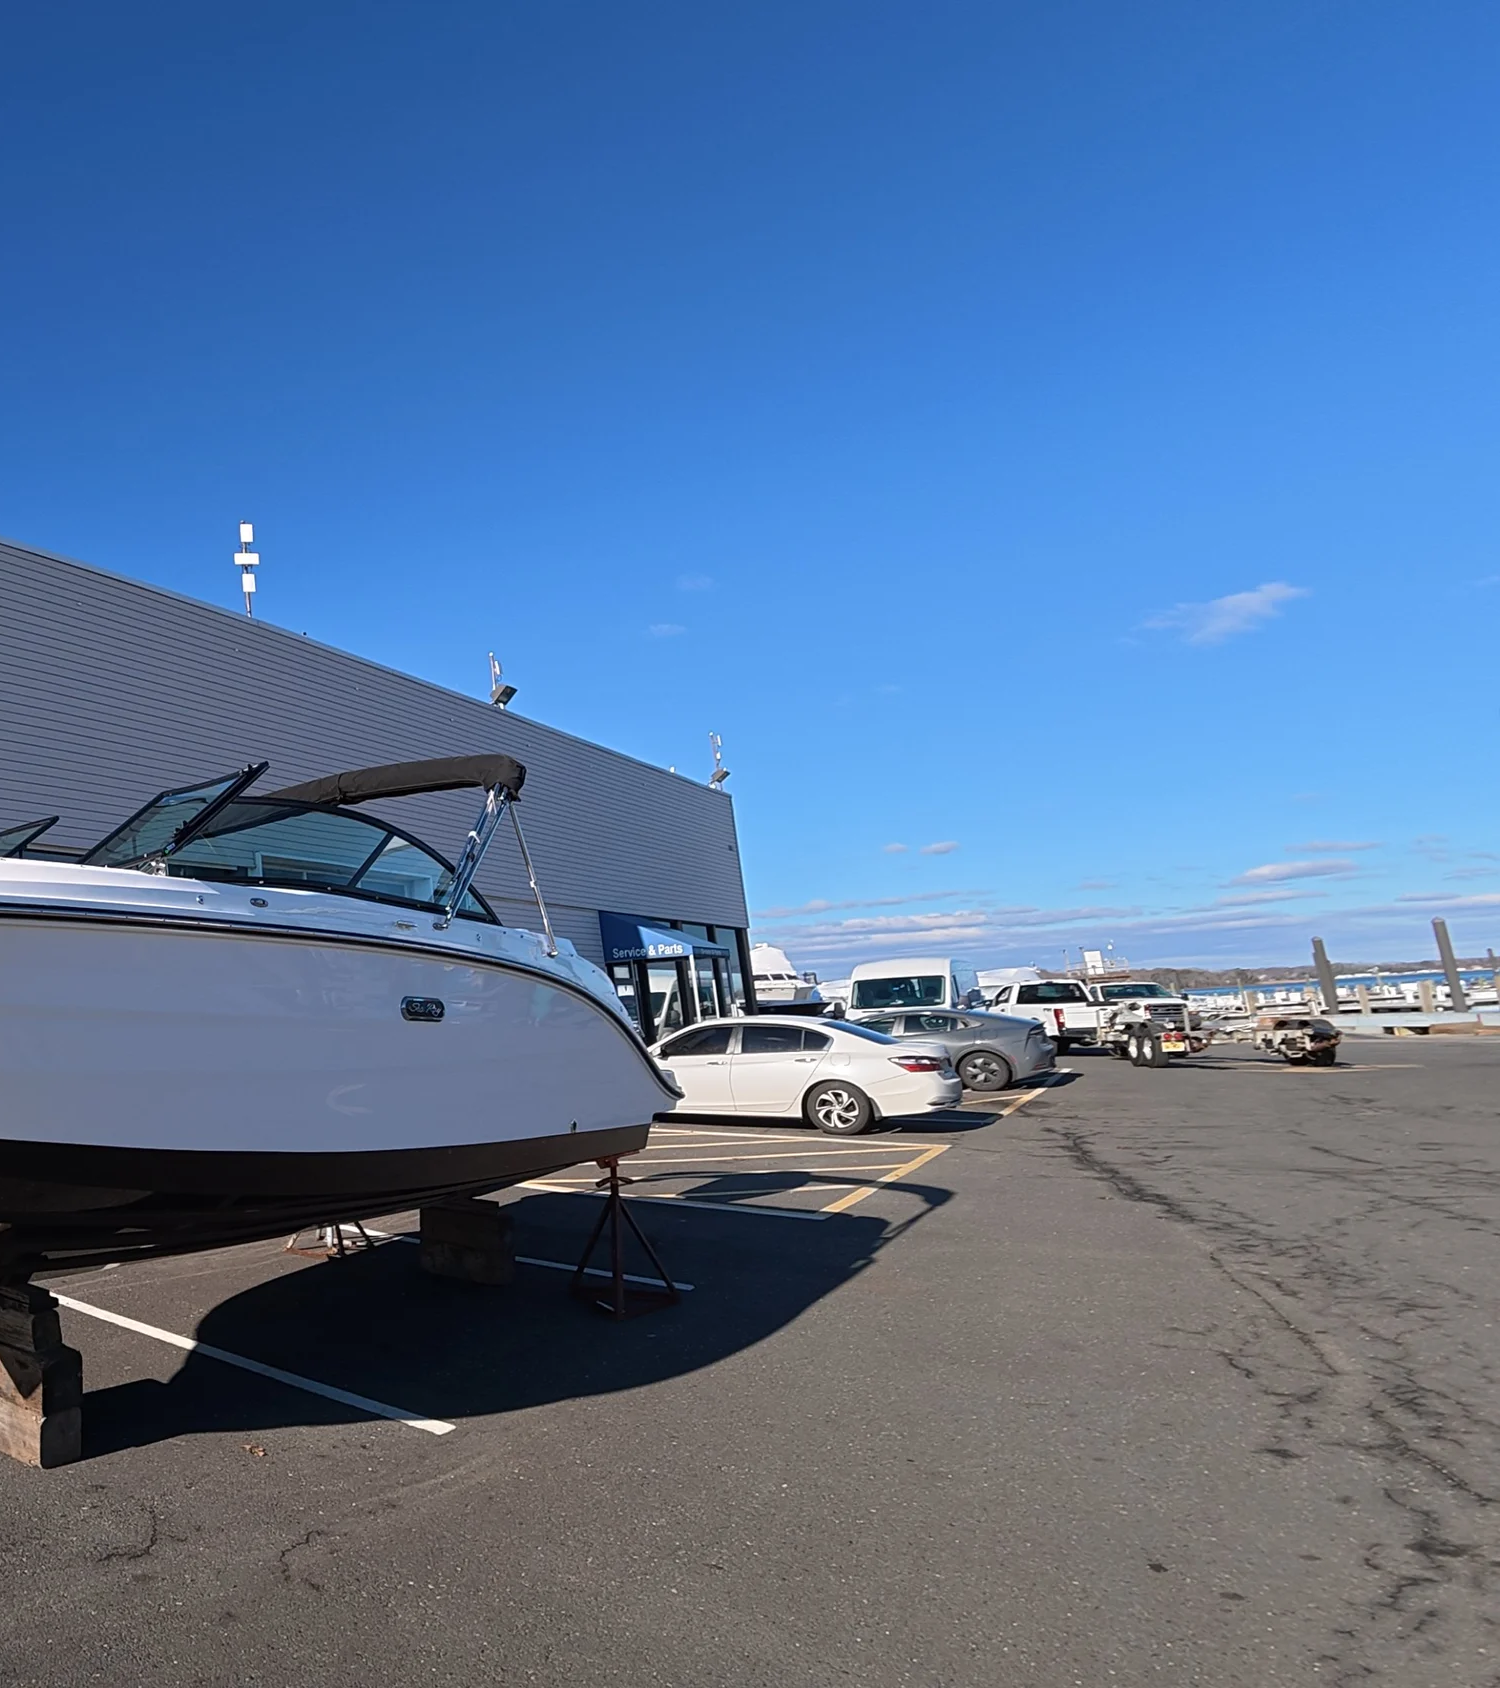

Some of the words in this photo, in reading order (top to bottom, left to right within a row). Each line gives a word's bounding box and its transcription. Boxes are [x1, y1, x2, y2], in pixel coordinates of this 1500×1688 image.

[612, 946, 646, 959] Service
[648, 944, 657, 956] &
[657, 943, 683, 956] Parts
